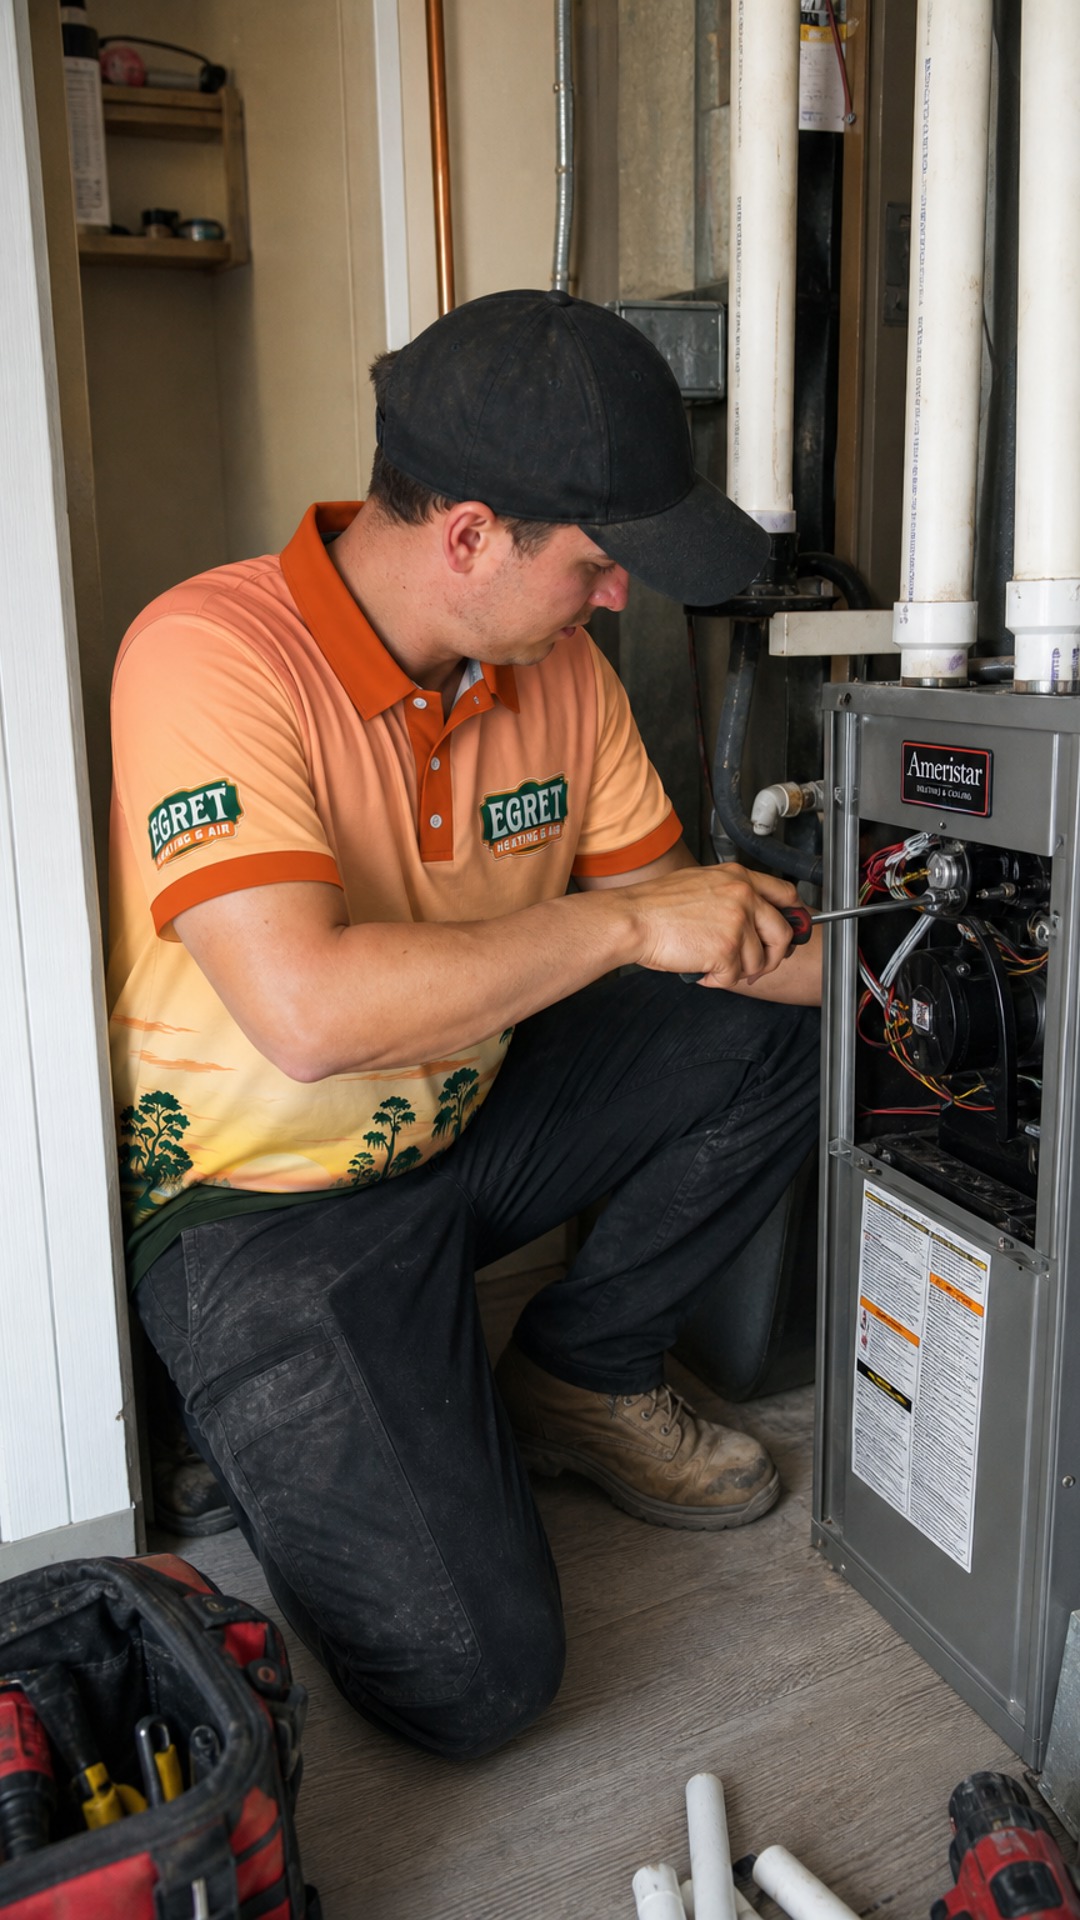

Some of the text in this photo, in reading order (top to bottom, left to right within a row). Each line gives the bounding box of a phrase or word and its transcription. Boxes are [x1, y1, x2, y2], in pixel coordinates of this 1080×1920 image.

[906, 752, 983, 786] Ameristar
[150, 787, 228, 853] EGRET
[208, 824, 230, 836] AIR
[488, 784, 562, 839] EGRET
